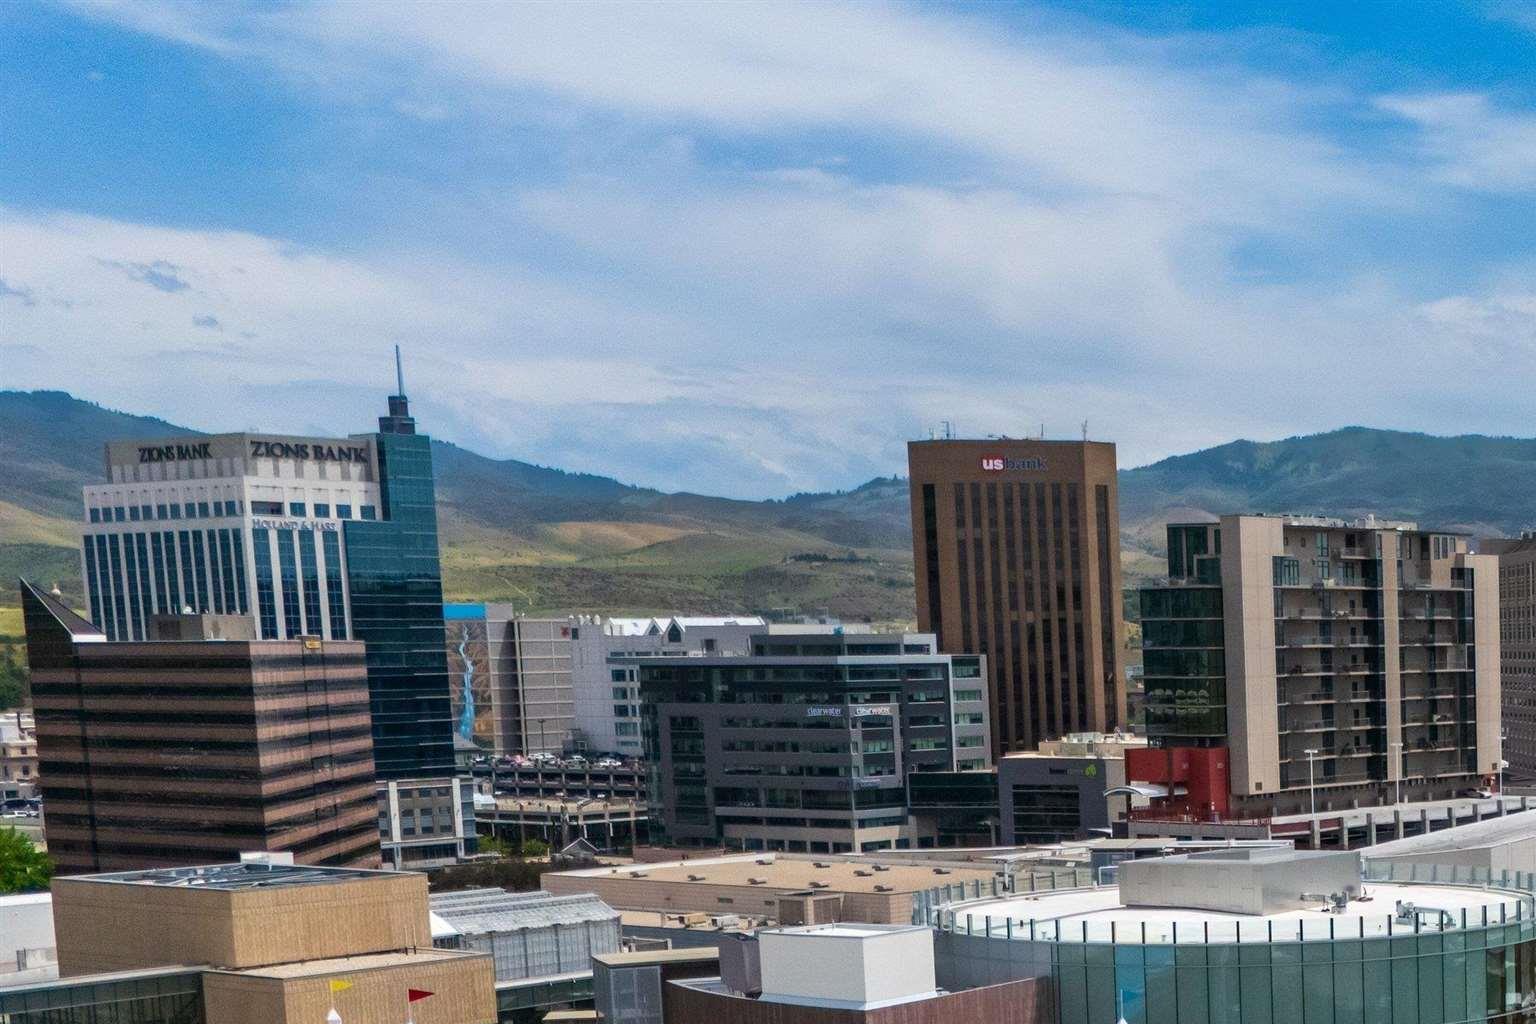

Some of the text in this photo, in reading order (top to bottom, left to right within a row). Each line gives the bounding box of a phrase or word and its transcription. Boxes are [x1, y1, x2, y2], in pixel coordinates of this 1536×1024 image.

[138, 442, 213, 464] ZIONS BANK
[251, 440, 369, 463] ZIONS BANK
